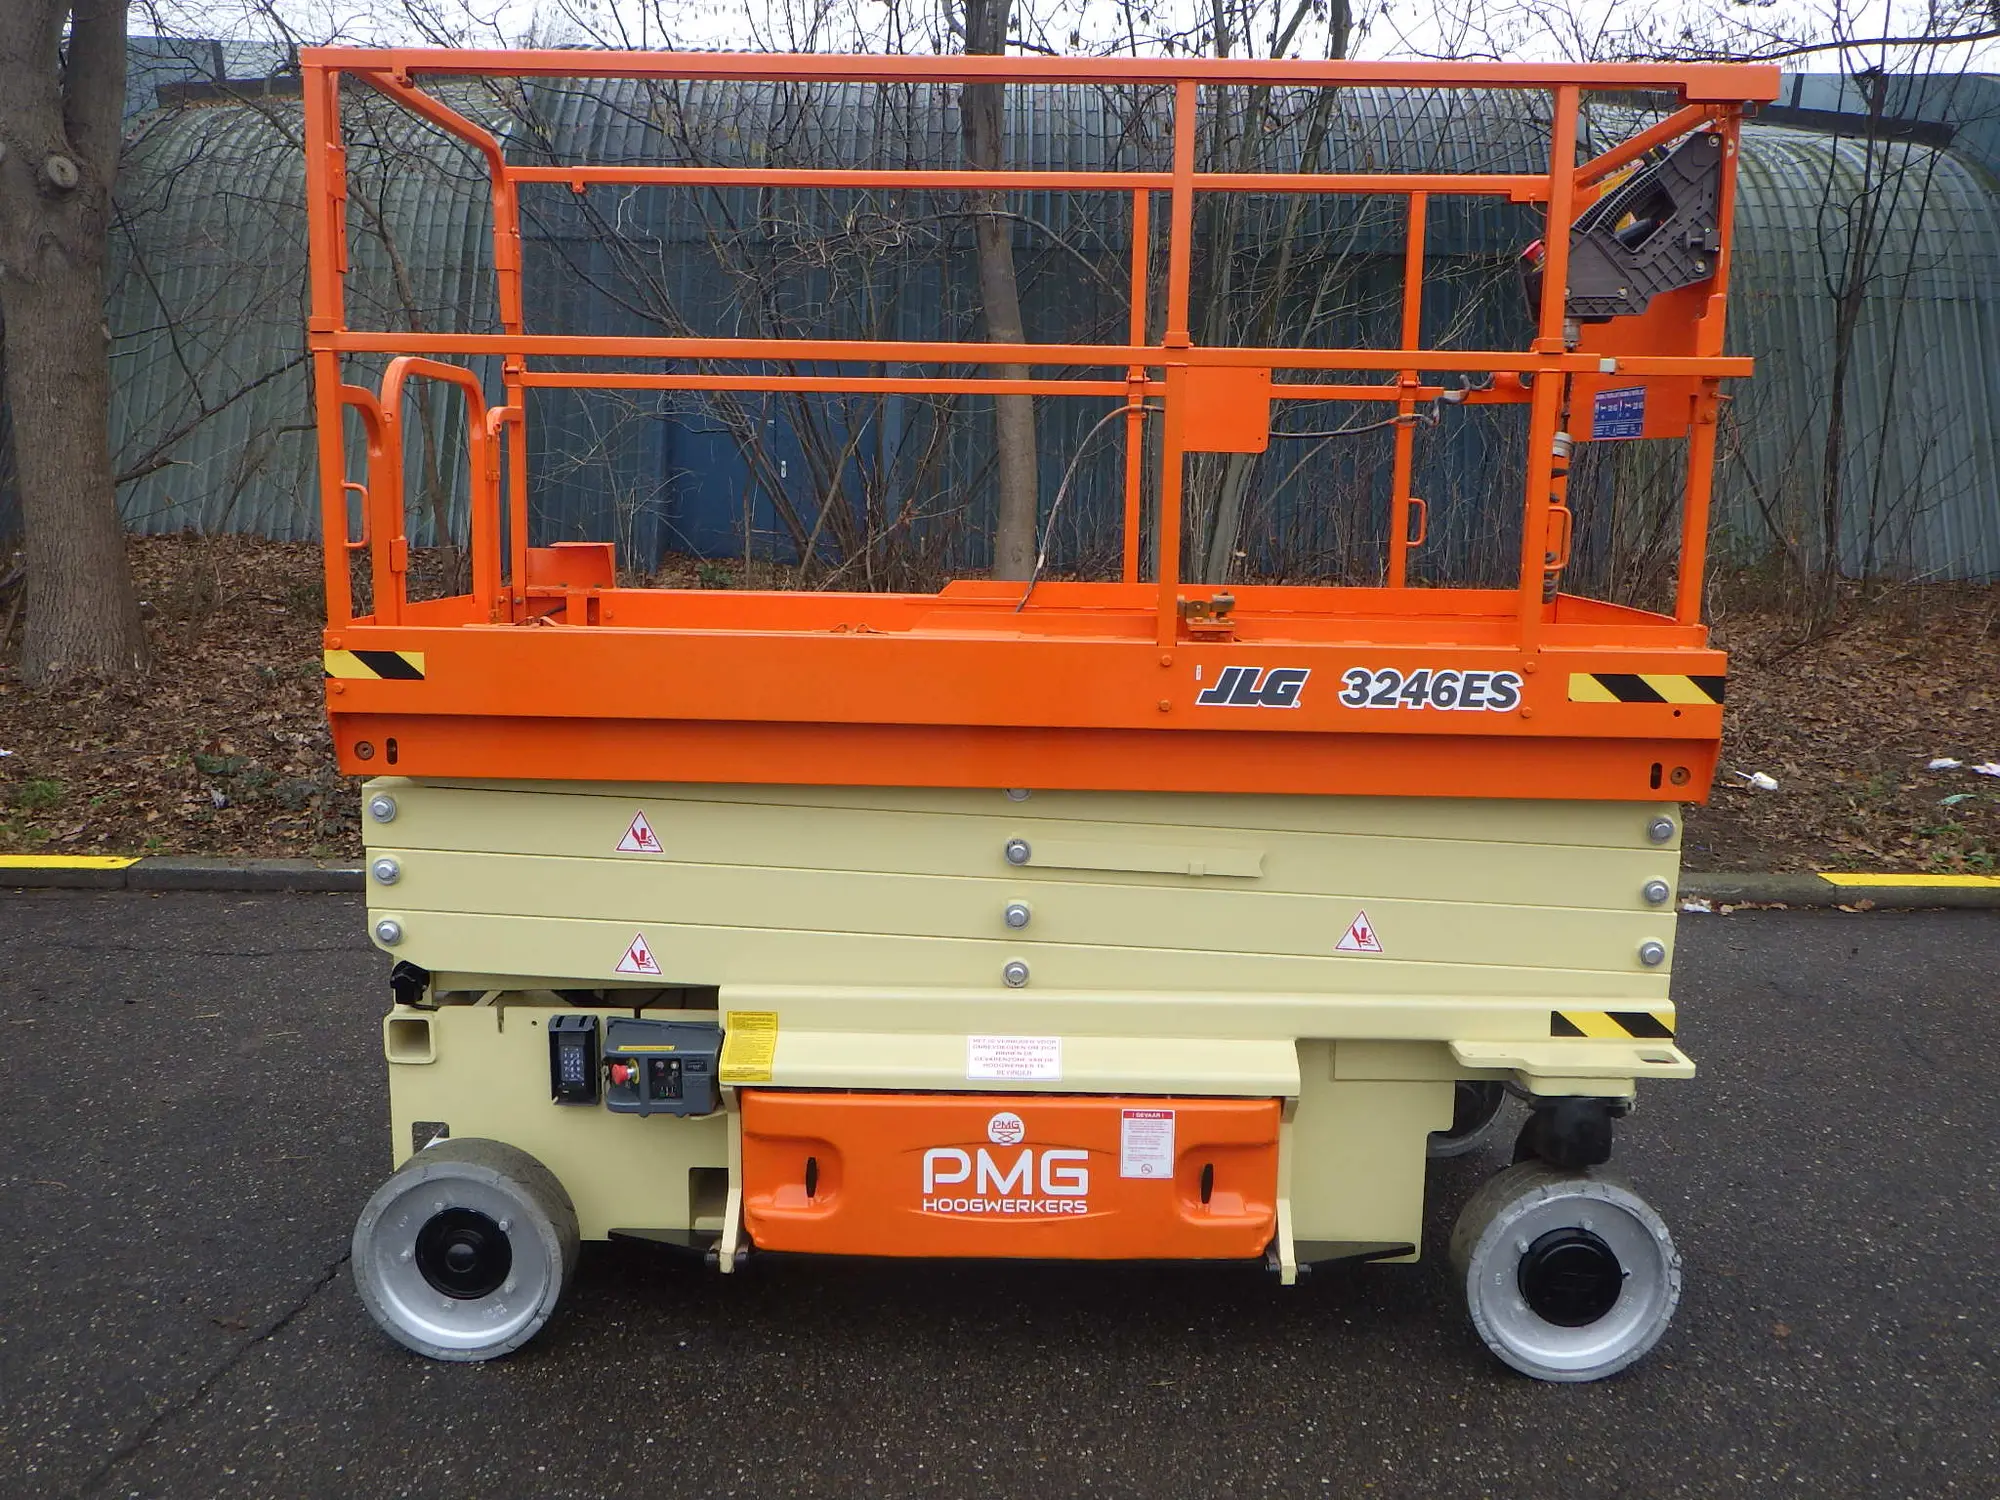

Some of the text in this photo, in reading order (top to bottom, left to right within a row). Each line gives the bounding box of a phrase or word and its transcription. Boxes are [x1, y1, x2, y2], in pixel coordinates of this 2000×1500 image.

[1195, 666, 1525, 712] JLG 3246ES
[992, 1120, 1021, 1129] PMG
[923, 1148, 1089, 1195] PMG
[923, 1198, 1088, 1214] HOOGWERKERS
